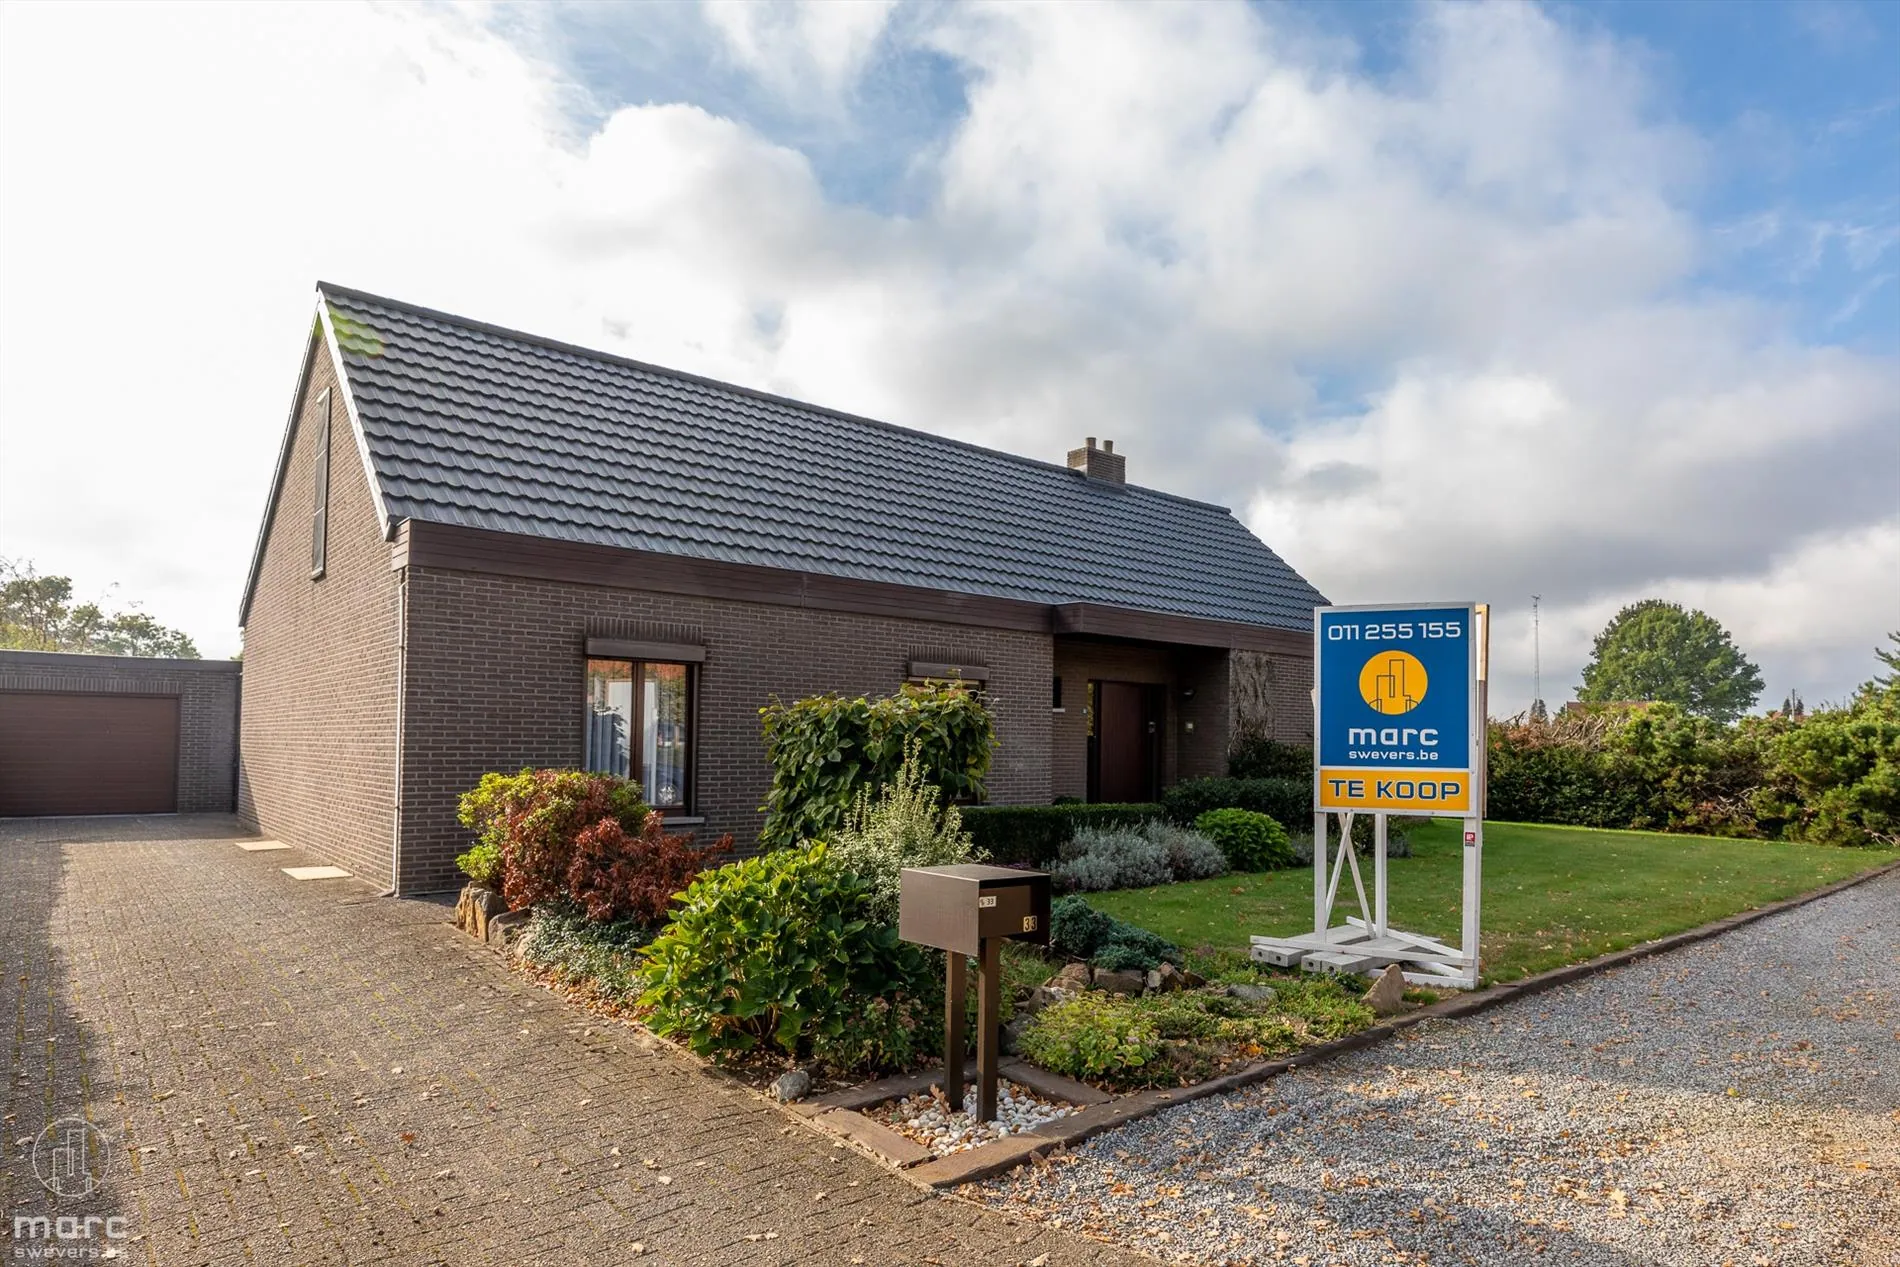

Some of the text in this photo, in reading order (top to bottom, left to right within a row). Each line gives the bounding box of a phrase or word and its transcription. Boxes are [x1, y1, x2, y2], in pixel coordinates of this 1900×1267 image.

[1328, 622, 1461, 640] 011 255 155
[1349, 728, 1438, 746] marc
[1349, 749, 1438, 760] swevers.be
[1328, 780, 1460, 800] TE KOOP
